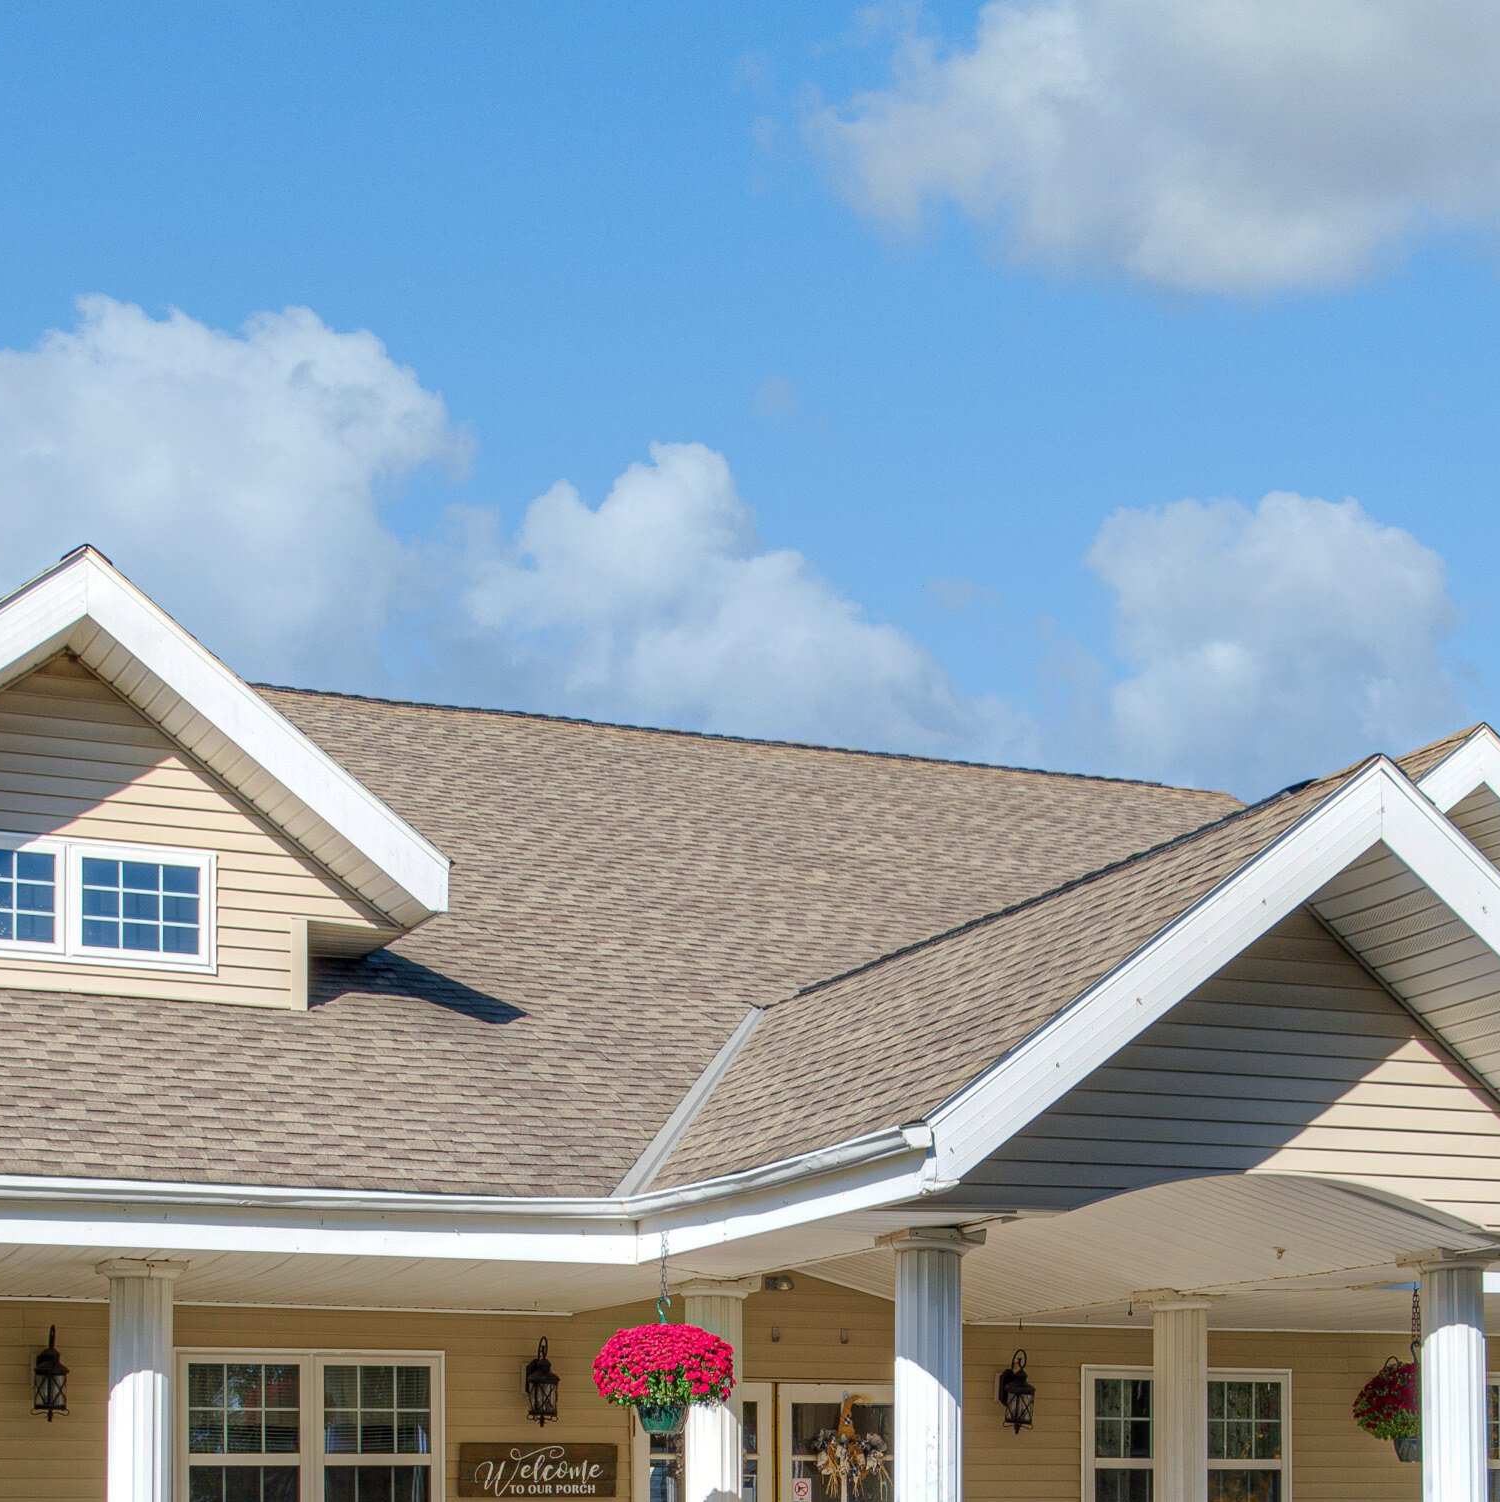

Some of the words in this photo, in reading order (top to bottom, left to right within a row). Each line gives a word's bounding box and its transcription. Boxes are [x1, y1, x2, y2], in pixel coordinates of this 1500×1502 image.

[475, 1446, 603, 1497] Welcome
[510, 1485, 524, 1494] TO
[528, 1485, 552, 1494] OUR
[556, 1485, 595, 1494] PORCH
